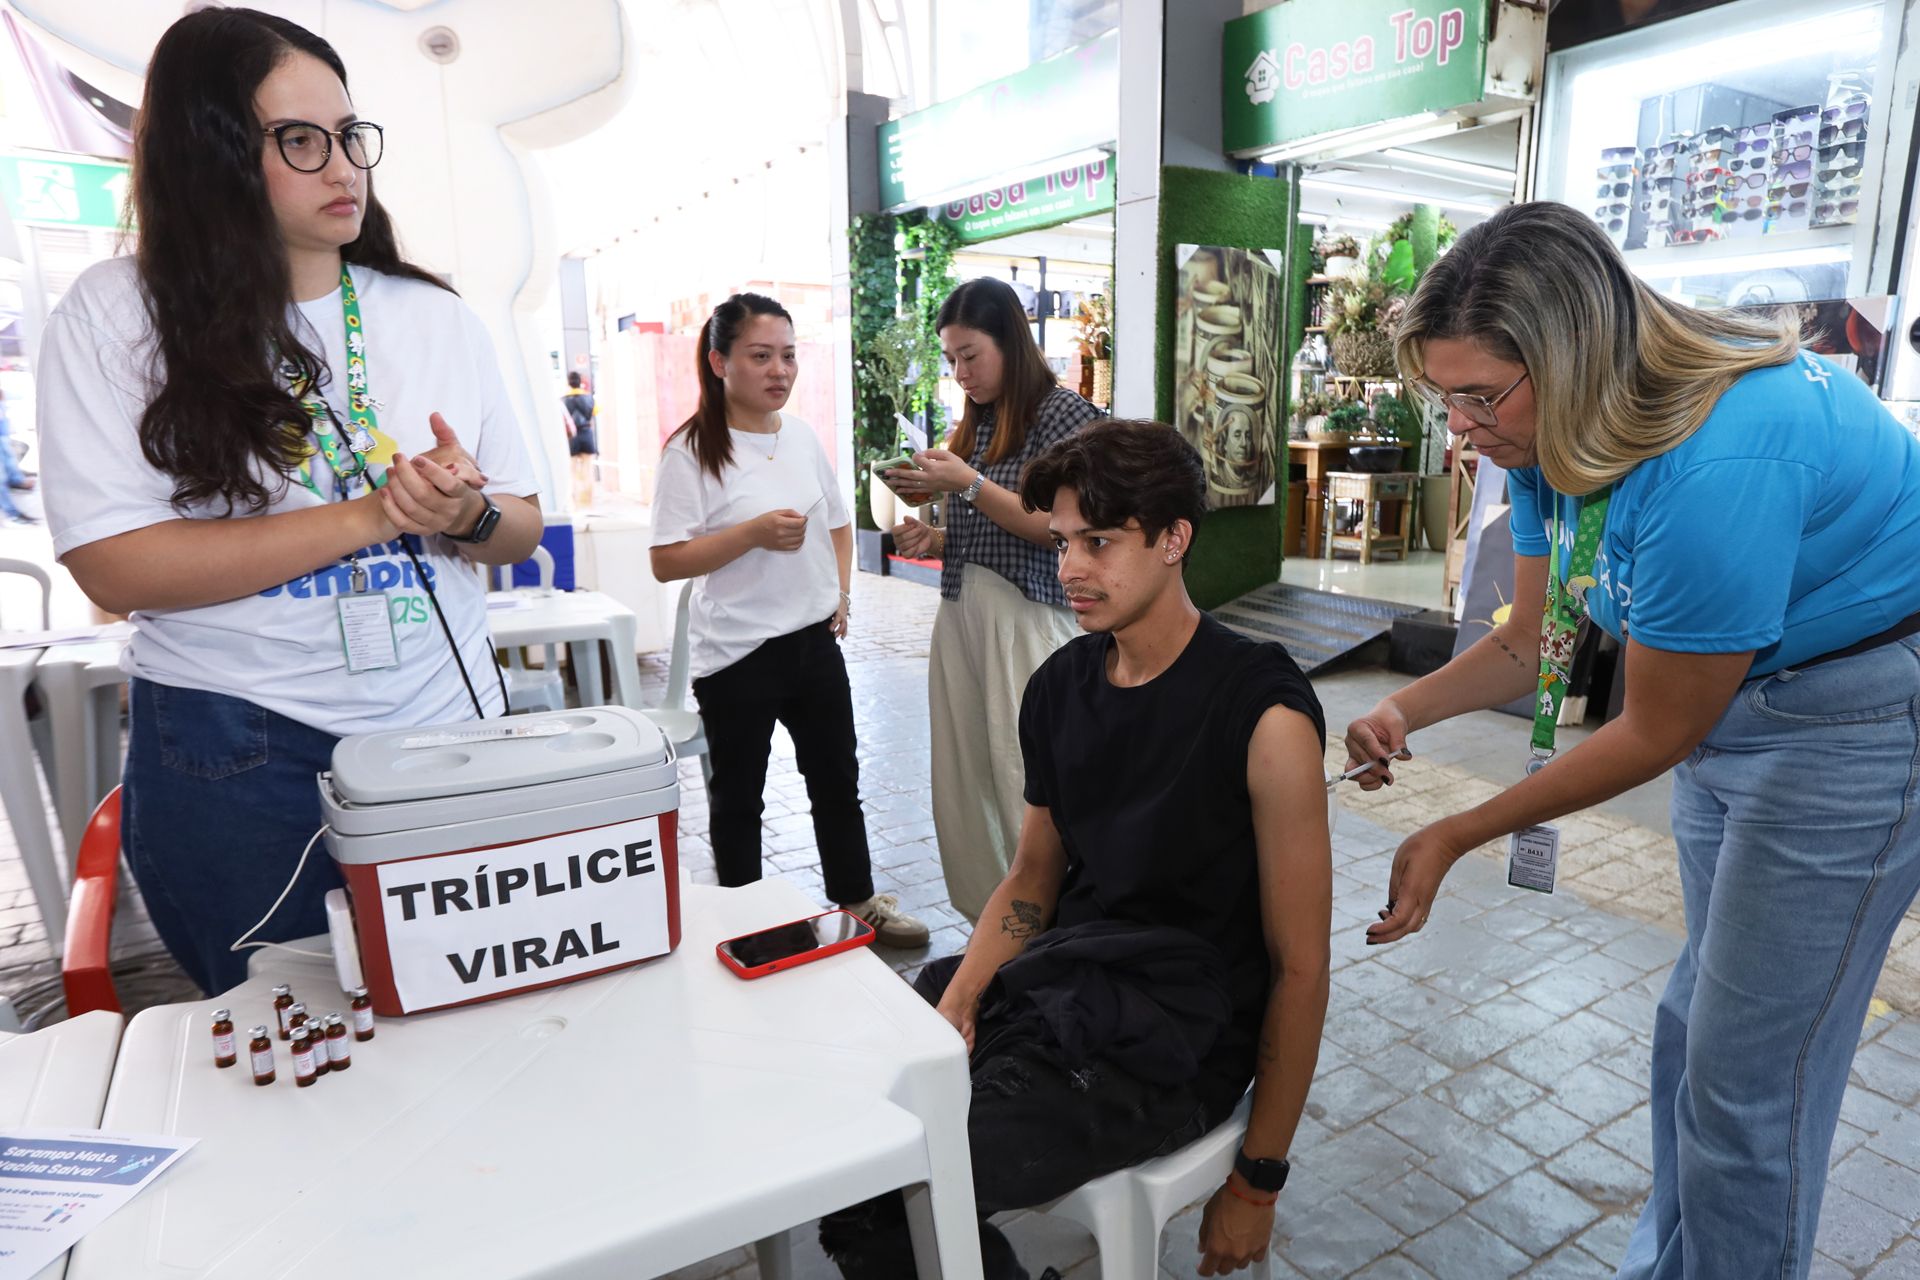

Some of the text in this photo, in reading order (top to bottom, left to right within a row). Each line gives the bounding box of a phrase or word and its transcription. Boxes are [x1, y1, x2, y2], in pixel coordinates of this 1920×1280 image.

[1284, 8, 1464, 89] Casa Top
[259, 560, 437, 599] empre
[387, 839, 656, 922] TRÍPLICE
[447, 921, 620, 985] VIRAL
[3, 1146, 75, 1161] Sarampo
[48, 1164, 102, 1176] Salva!
